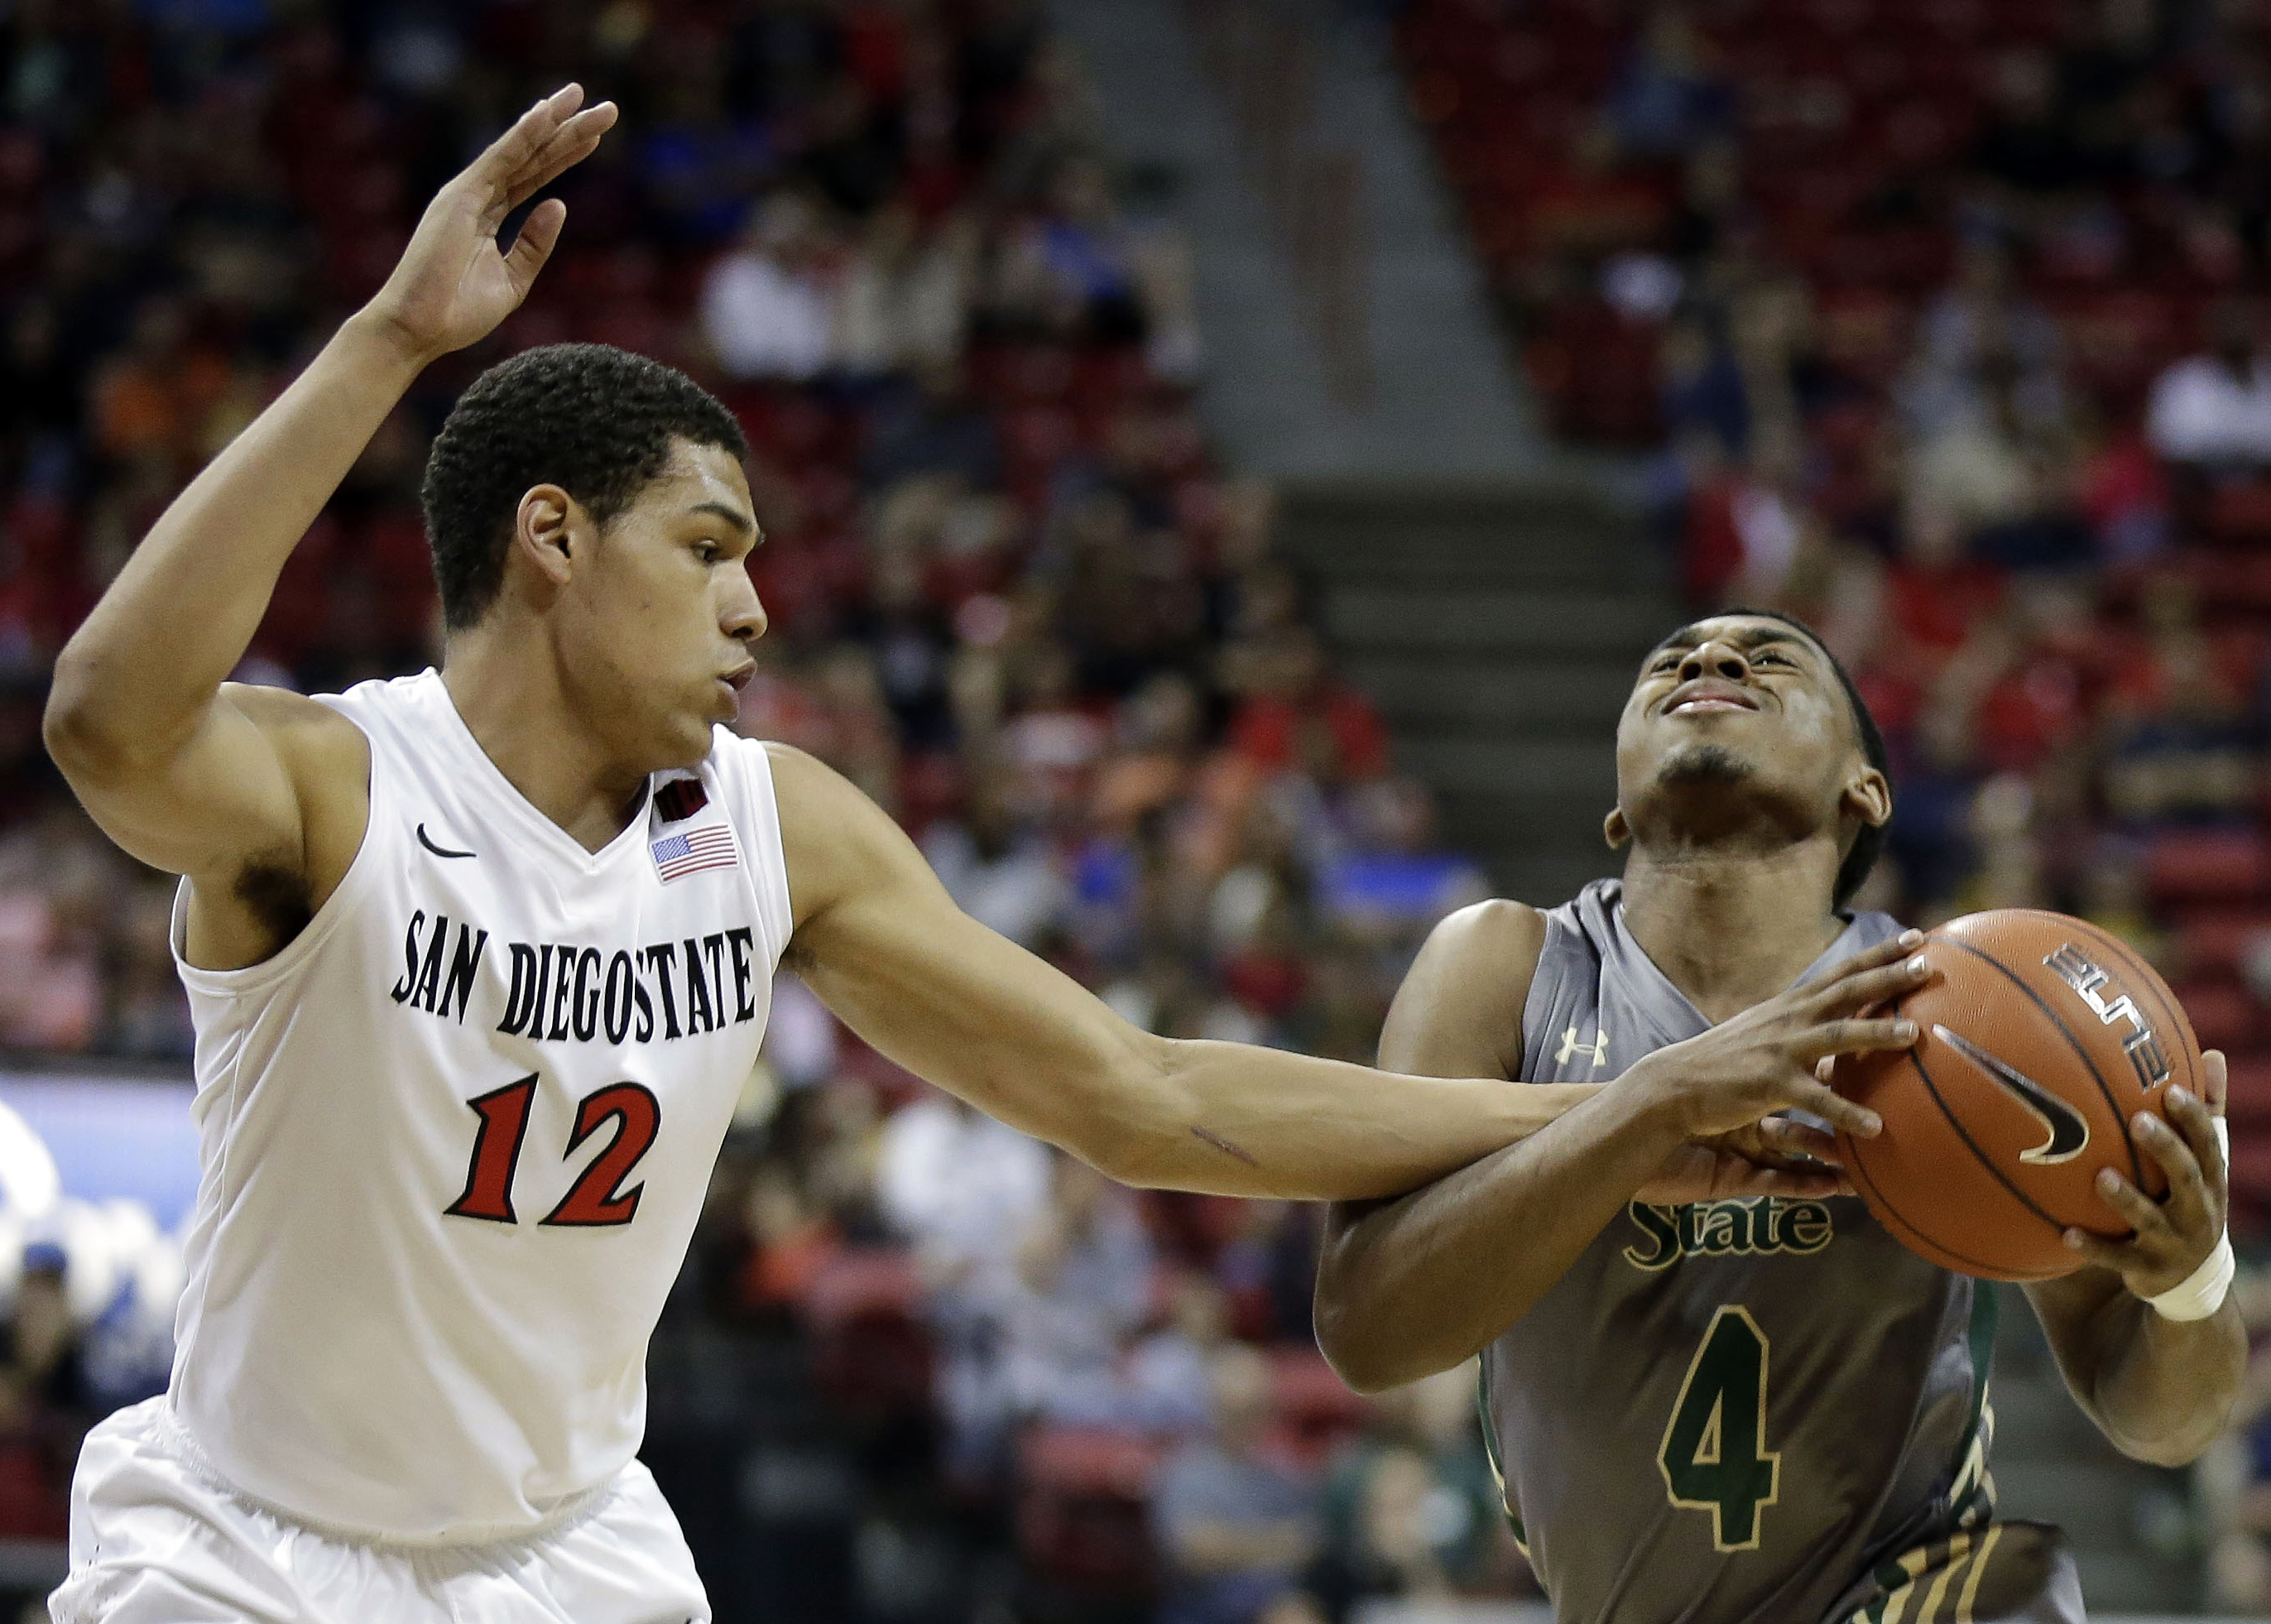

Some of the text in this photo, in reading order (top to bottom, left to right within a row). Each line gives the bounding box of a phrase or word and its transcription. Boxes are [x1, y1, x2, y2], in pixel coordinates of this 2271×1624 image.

[391, 910, 756, 1045] SAN DIEGO STATE
[443, 1072, 661, 1227] 12
[1622, 1197, 1834, 1271] State
[1657, 1304, 1781, 1553] 4
